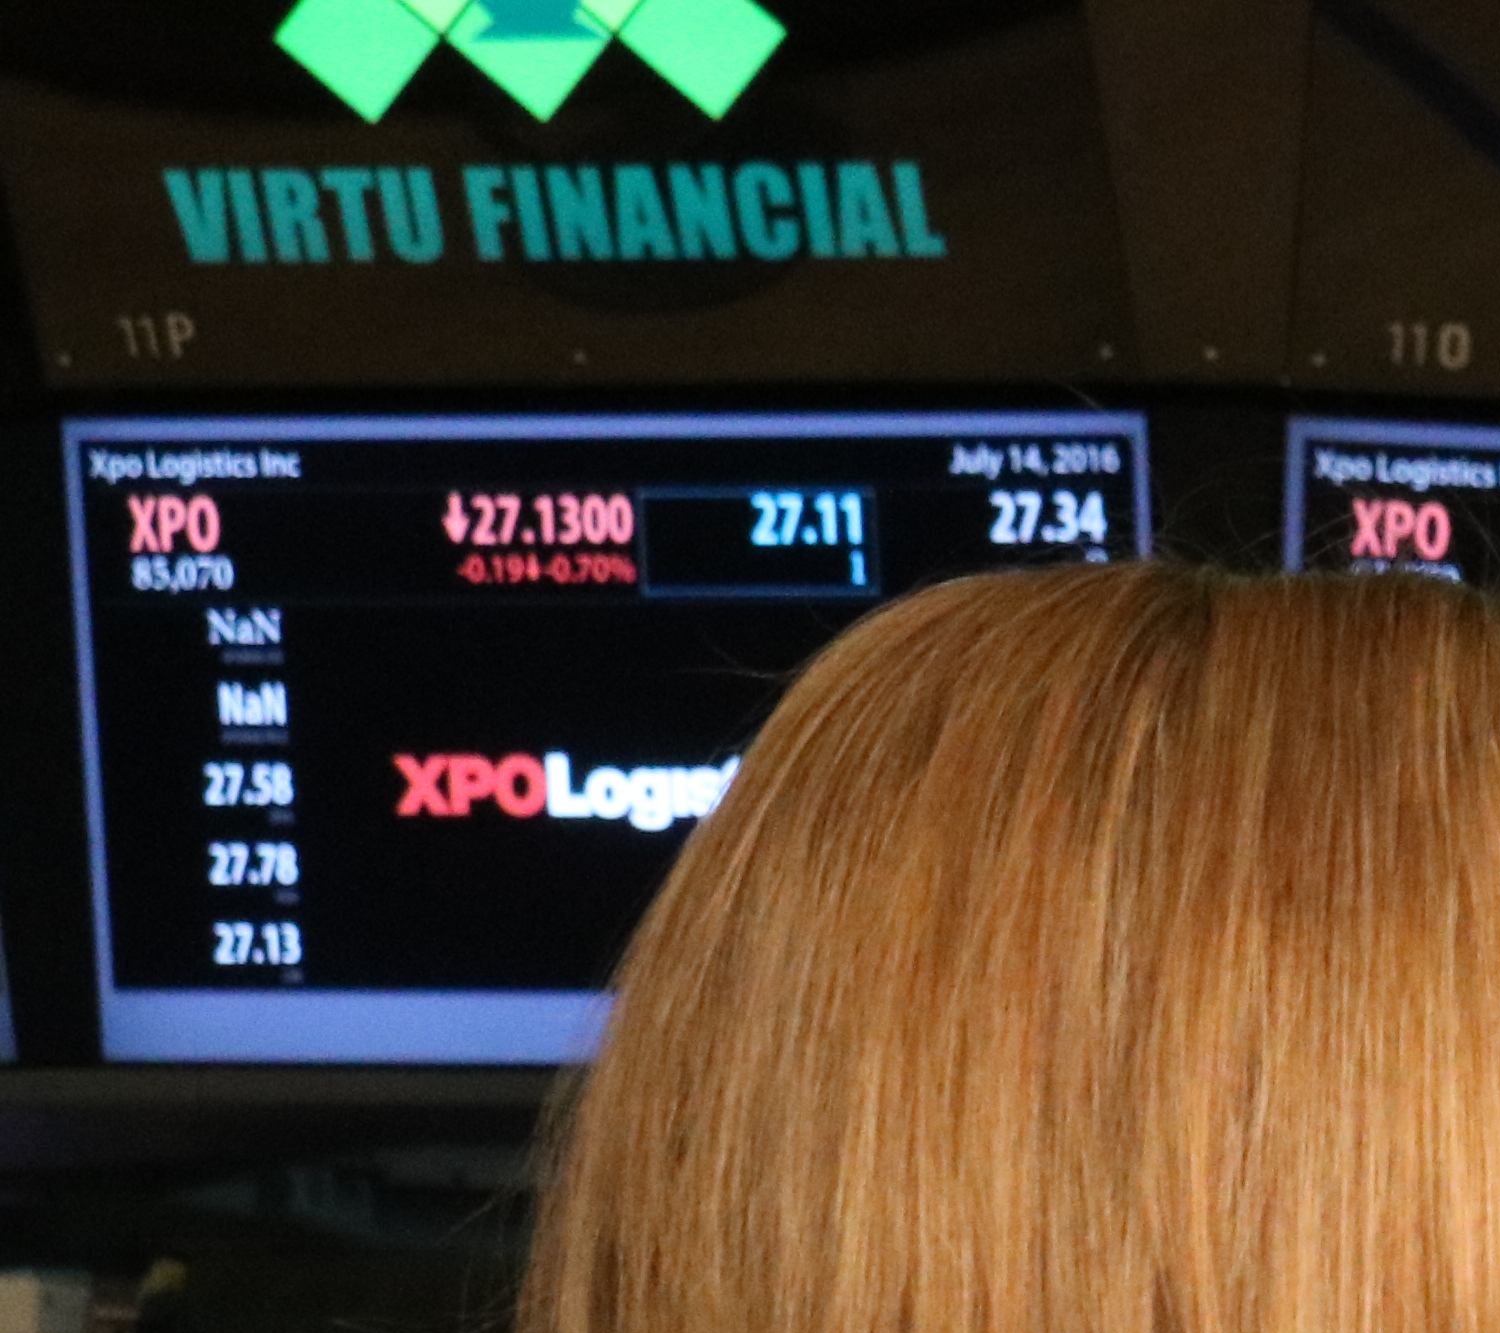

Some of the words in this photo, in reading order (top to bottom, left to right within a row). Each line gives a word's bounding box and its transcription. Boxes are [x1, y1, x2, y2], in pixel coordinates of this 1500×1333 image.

[163, 167, 443, 263] VIRTU
[462, 161, 946, 260] FINANCIAL
[145, 450, 258, 486] Logistics
[260, 450, 300, 478] Inc
[950, 443, 1003, 480] July
[1009, 443, 1049, 476] 14,
[1052, 443, 1121, 474] 2016
[1375, 453, 1497, 492] Logistics
[129, 495, 220, 553] XPO
[471, 494, 635, 546] 27.1300
[750, 491, 865, 546] 27.11
[989, 489, 1108, 544] 27.34
[1350, 498, 1452, 561] XPO
[131, 556, 234, 593] 85,070
[206, 608, 282, 646] NaN
[217, 681, 289, 726] NaN
[203, 762, 295, 807] 27.58
[208, 841, 300, 887] 27.78
[213, 921, 303, 966] 27.13
